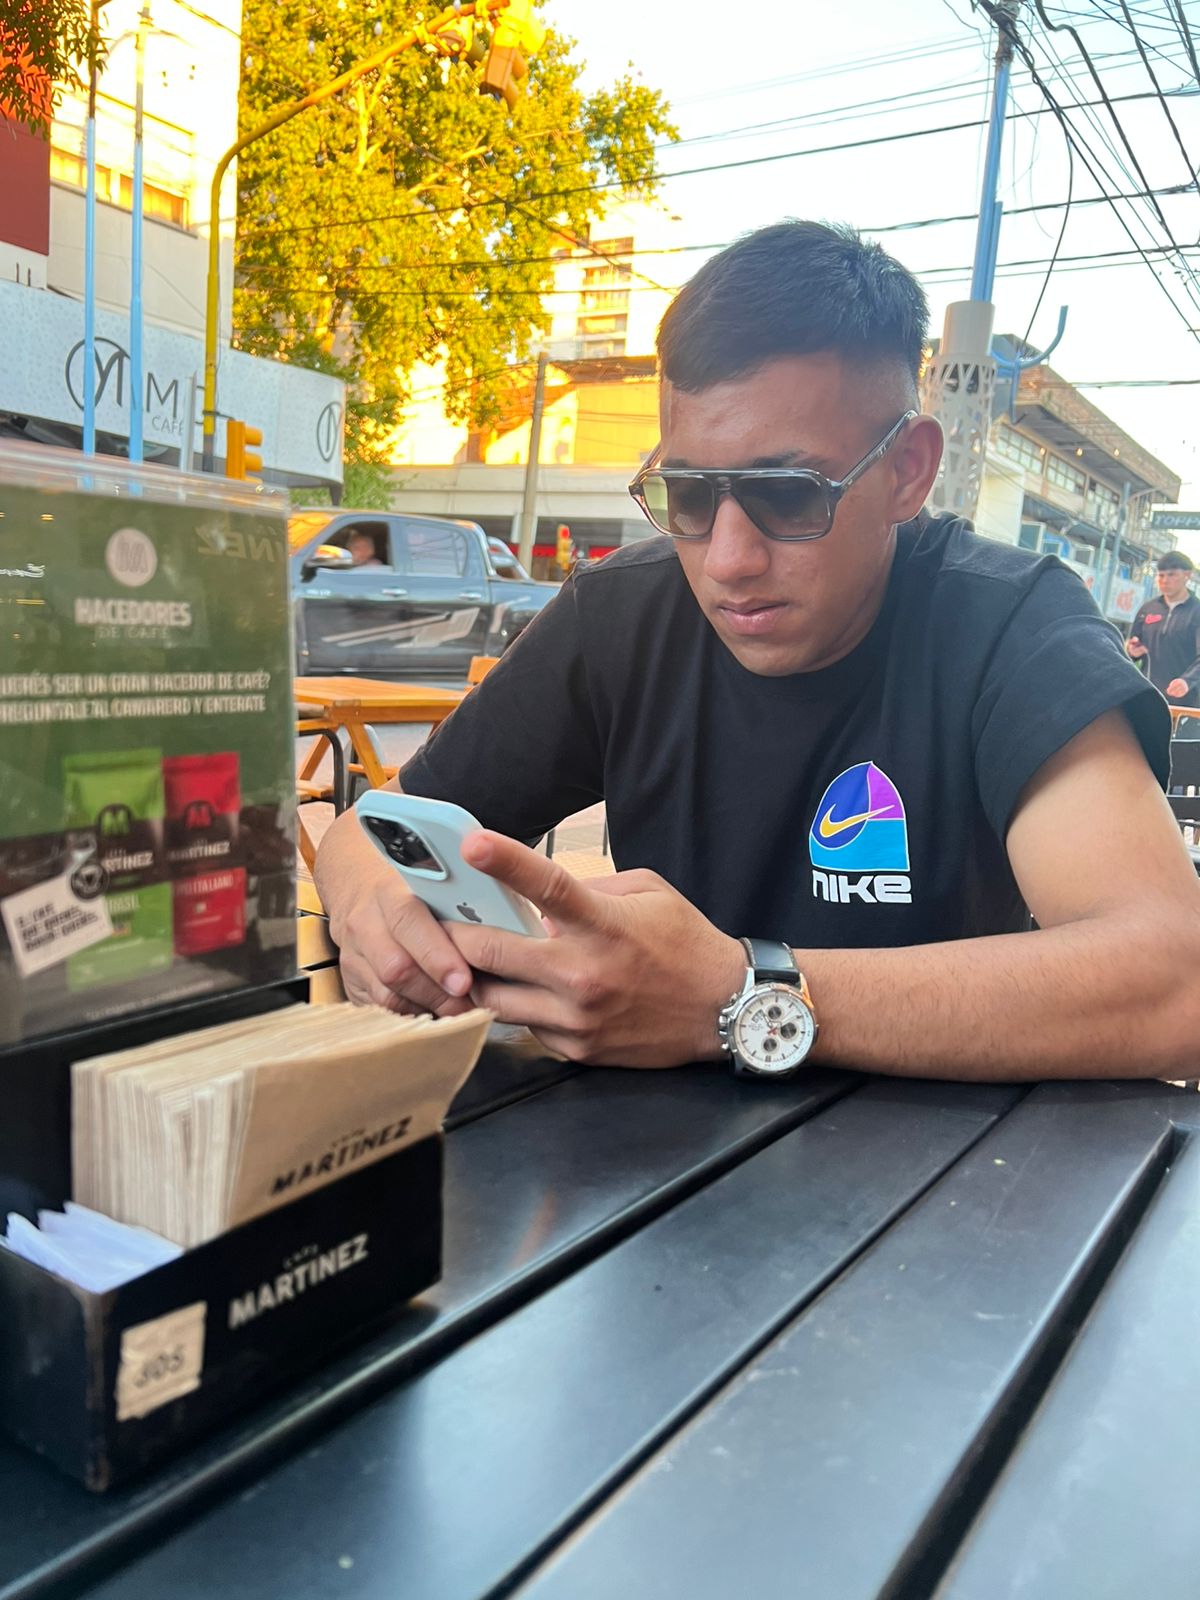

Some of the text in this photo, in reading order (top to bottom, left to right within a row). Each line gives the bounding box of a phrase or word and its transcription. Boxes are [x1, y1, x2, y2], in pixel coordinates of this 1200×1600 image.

[1154, 515, 1200, 526] TOPP
[75, 599, 192, 626] HACEDORES
[99, 627, 119, 639] DE
[0, 668, 271, 697] UERÉS SER UN GRAN HACEDOR DE CAFÉ?
[0, 700, 90, 723] REGUNTALE
[111, 697, 191, 717] CAMARERO
[193, 697, 202, 714] Y
[204, 695, 266, 714] ENTERATE
[270, 1115, 412, 1196] MARTINEZ
[228, 1233, 369, 1331] MARTINEZ
